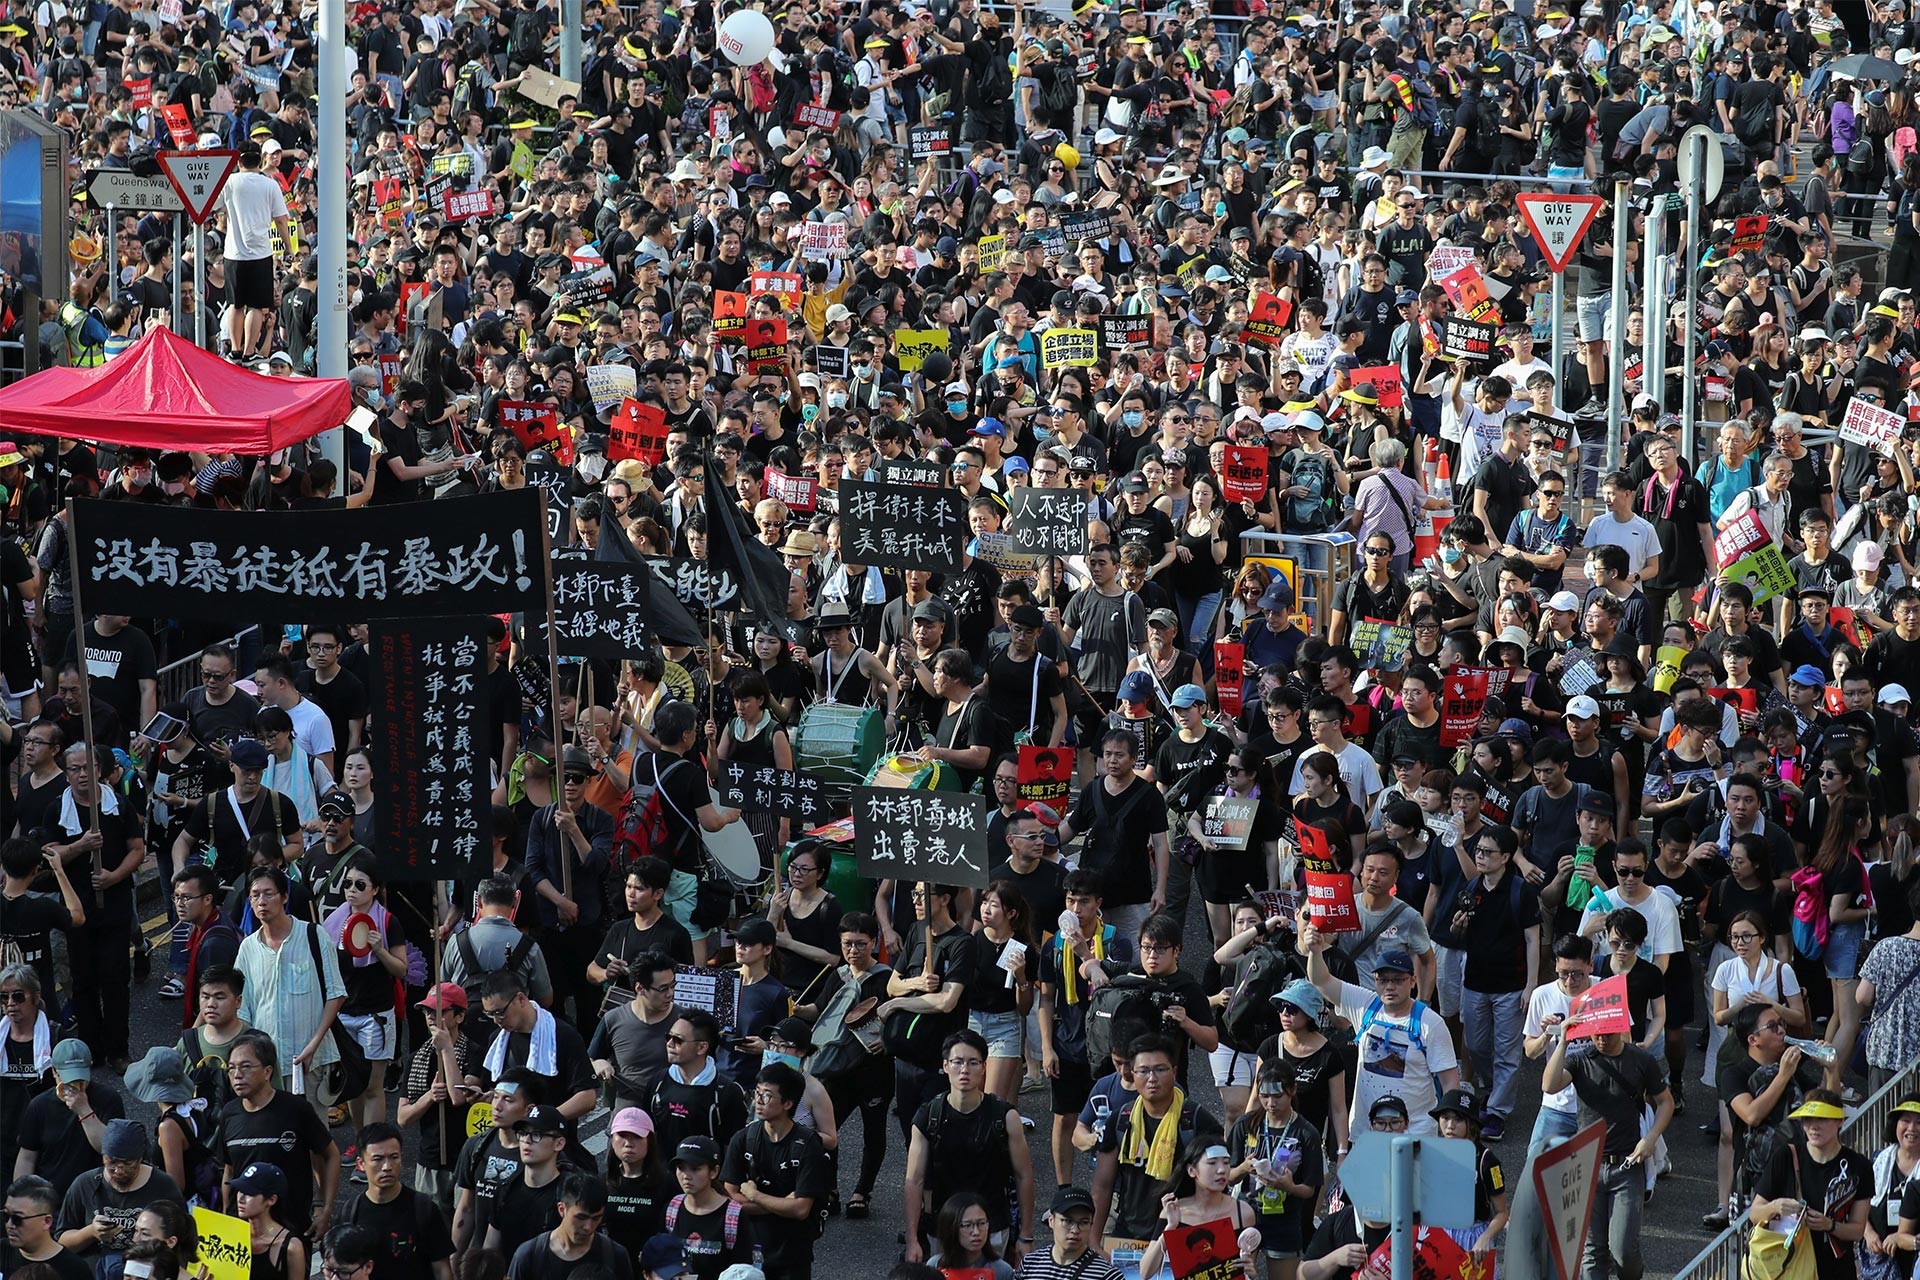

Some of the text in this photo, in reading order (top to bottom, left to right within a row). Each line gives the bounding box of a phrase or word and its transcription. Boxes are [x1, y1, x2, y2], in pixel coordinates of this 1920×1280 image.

[912, 131, 948, 142] 獨立調查
[186, 163, 210, 171] GIVE
[110, 176, 171, 190] Queensway
[187, 172, 210, 181] WAY
[193, 185, 204, 196] 讓
[119, 193, 164, 207] 金鐘道
[449, 193, 486, 206] 全面撤回
[1543, 203, 1572, 214] GIVE
[1544, 216, 1572, 226] WAY
[808, 222, 843, 236] 相信青年
[807, 236, 845, 249] 相信人民
[1434, 248, 1471, 259] 相信青年
[755, 278, 797, 292] 賣港賊
[714, 320, 744, 330] 林鄭下台
[1104, 320, 1148, 331] 獨立調查
[1249, 322, 1281, 335] 林鄭下台
[1447, 322, 1490, 341] 獨立調查
[1044, 334, 1094, 347] 企硬立場
[1446, 333, 1489, 353] 警察鎮壓
[750, 345, 786, 358] 林鄭下台
[1045, 346, 1094, 363] 追究警暴
[1305, 356, 1326, 366] AME
[1849, 401, 1901, 430] 相信青年
[1845, 415, 1895, 441] 相信人民
[886, 466, 940, 483] 獨立調查
[1228, 465, 1263, 479] 反送中
[768, 473, 811, 492] 全面撤回
[849, 490, 957, 527] 捍衛未來
[1015, 494, 1085, 527] 人不送中
[853, 528, 955, 565] 美麗我城
[943, 578, 982, 605] MERICAN
[84, 647, 122, 662] TORONTO
[1446, 700, 1482, 715] 反送中
[727, 763, 818, 791] 中環割地
[1020, 782, 1067, 796] 林鄭下台
[728, 788, 818, 815] 兩制不存
[867, 794, 976, 832] 林鄭毒蛾
[1205, 803, 1250, 821] 獨立調查
[870, 829, 980, 872] 出賣港人
[1095, 1010, 1111, 1018] Canon
[1594, 1008, 1622, 1017] Extradition
[244, 1166, 257, 1178] S
[1560, 1162, 1581, 1188] GIVE
[607, 1196, 652, 1205] ENERGY SAVING
[1560, 1189, 1581, 1212] WAY
